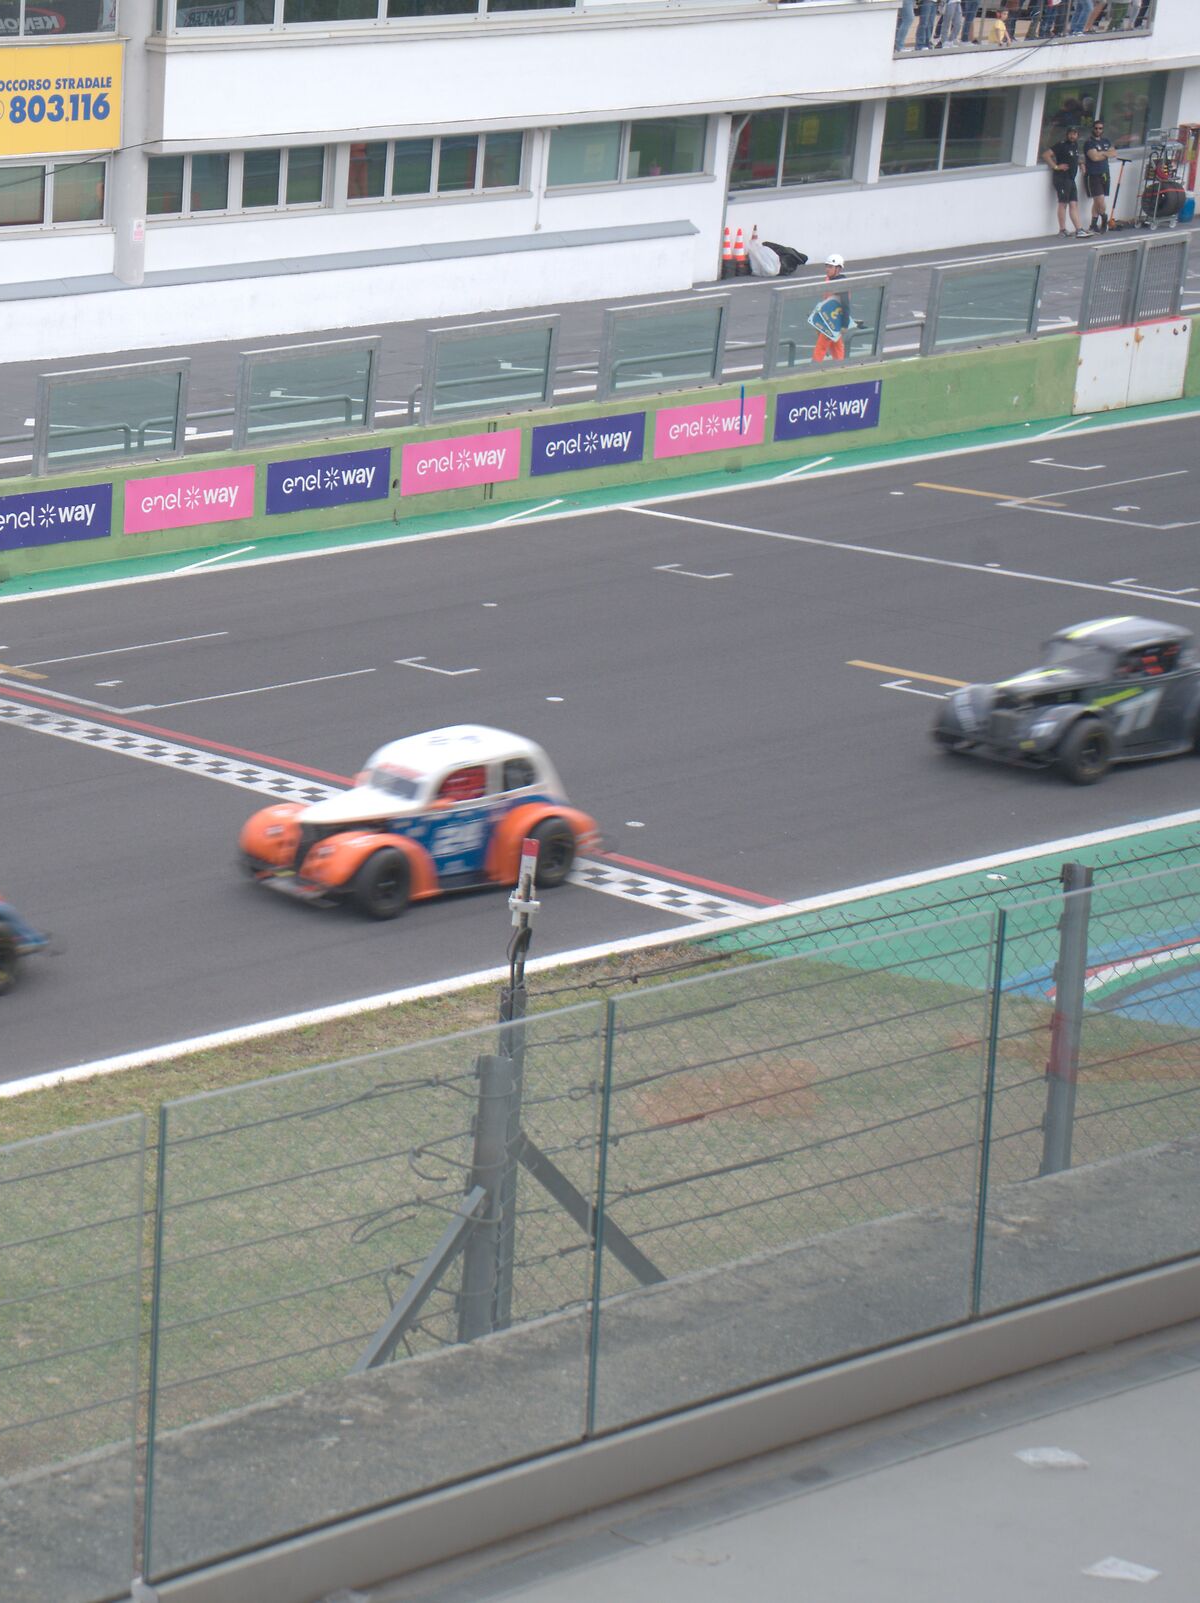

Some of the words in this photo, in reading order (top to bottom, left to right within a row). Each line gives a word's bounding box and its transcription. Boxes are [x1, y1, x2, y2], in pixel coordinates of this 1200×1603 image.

[55, 77, 112, 91] STRADALE
[9, 93, 111, 124] 803.116
[788, 400, 822, 424] enel
[839, 397, 869, 418] way
[668, 416, 704, 440] enel
[545, 433, 581, 457] enel
[599, 430, 632, 452] way
[416, 451, 454, 476] enel
[473, 448, 507, 470] way
[282, 469, 321, 494] enel
[341, 466, 376, 488] way
[140, 488, 182, 513] enel
[203, 485, 239, 507] way
[58, 503, 97, 526] way
